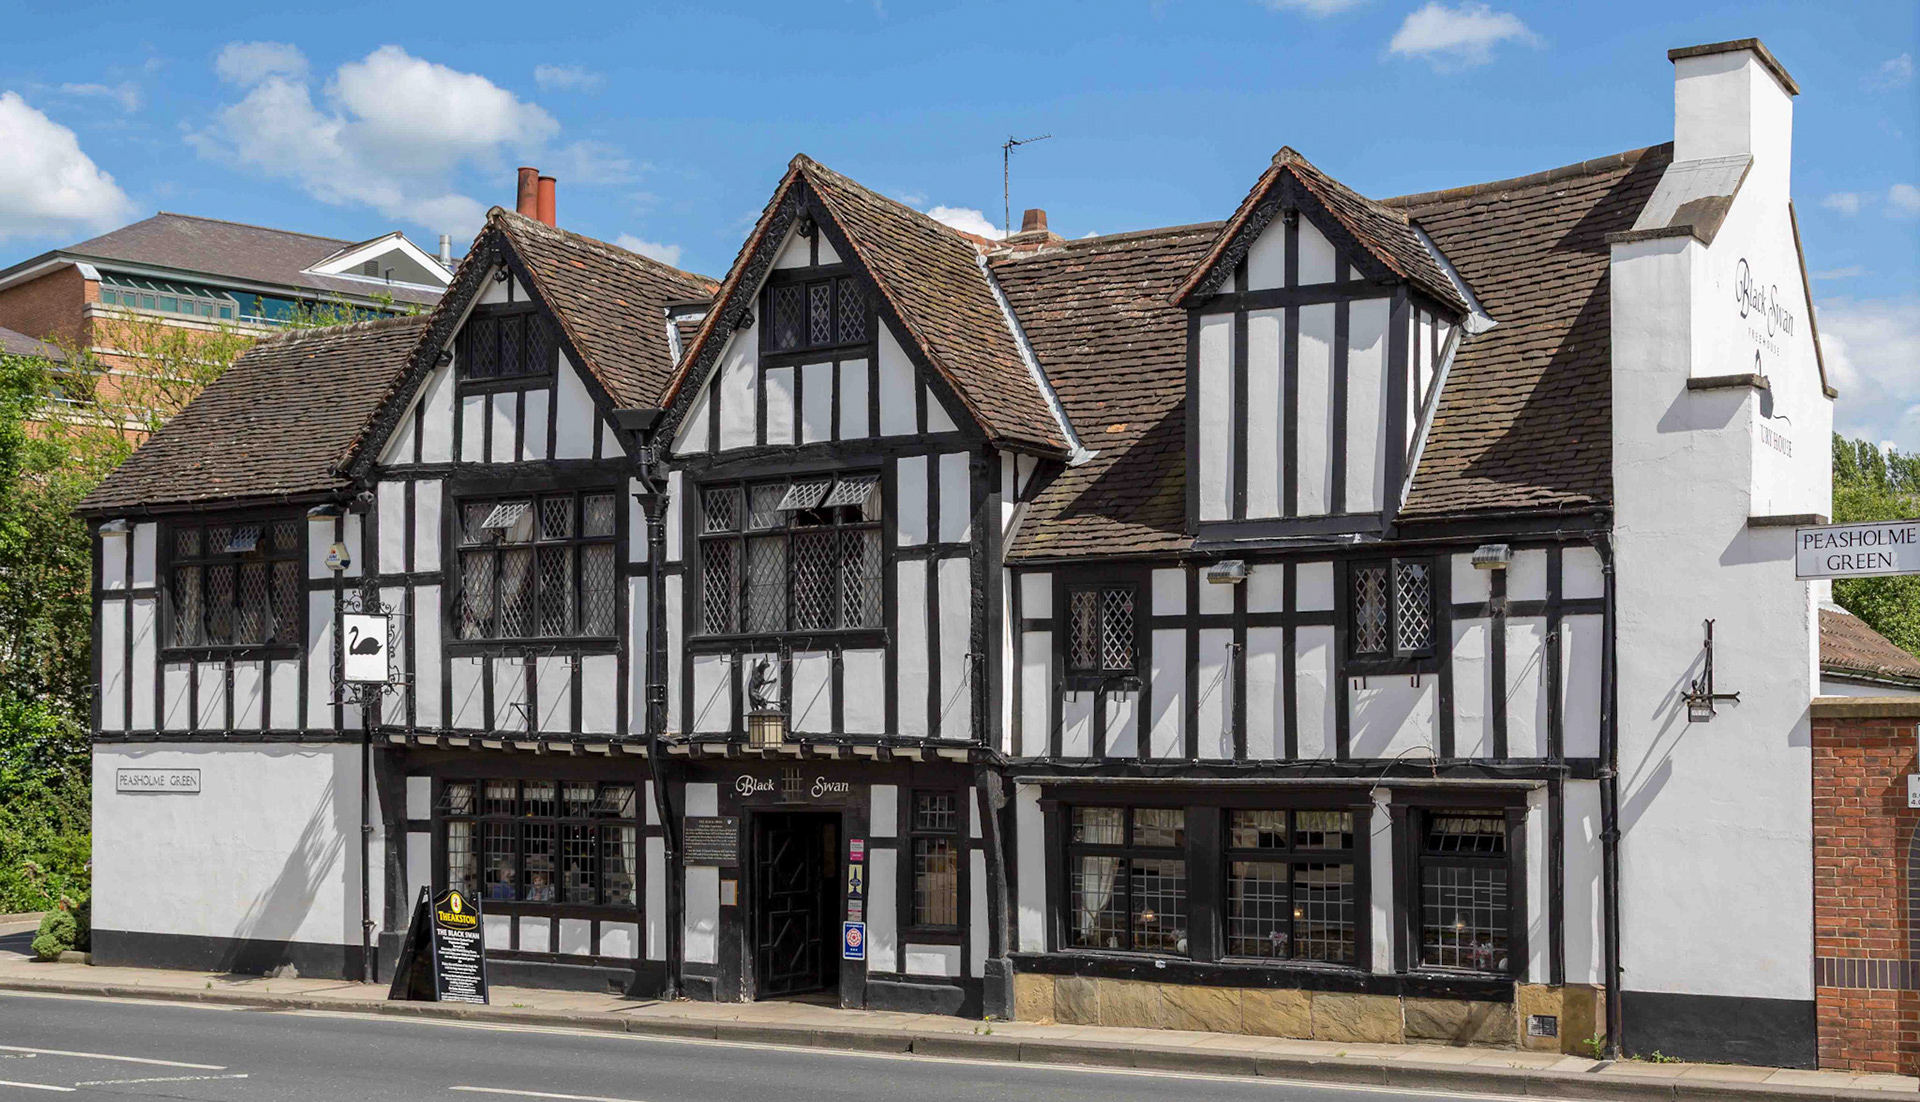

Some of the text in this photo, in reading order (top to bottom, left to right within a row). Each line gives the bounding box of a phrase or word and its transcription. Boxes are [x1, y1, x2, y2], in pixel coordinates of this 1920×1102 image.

[1735, 257, 1794, 338] Black Swan
[1748, 327, 1780, 357] FREEHOUSE
[1803, 528, 1917, 550] PEASHOLME
[1827, 551, 1893, 571] GREEN
[119, 774, 197, 787] PEASHOLME GREEN
[735, 774, 850, 798] Black Swan
[438, 911, 476, 925] THEAKSTON
[436, 928, 447, 936] THE
[448, 929, 464, 938] BLACK
[465, 931, 480, 940] SWAN
